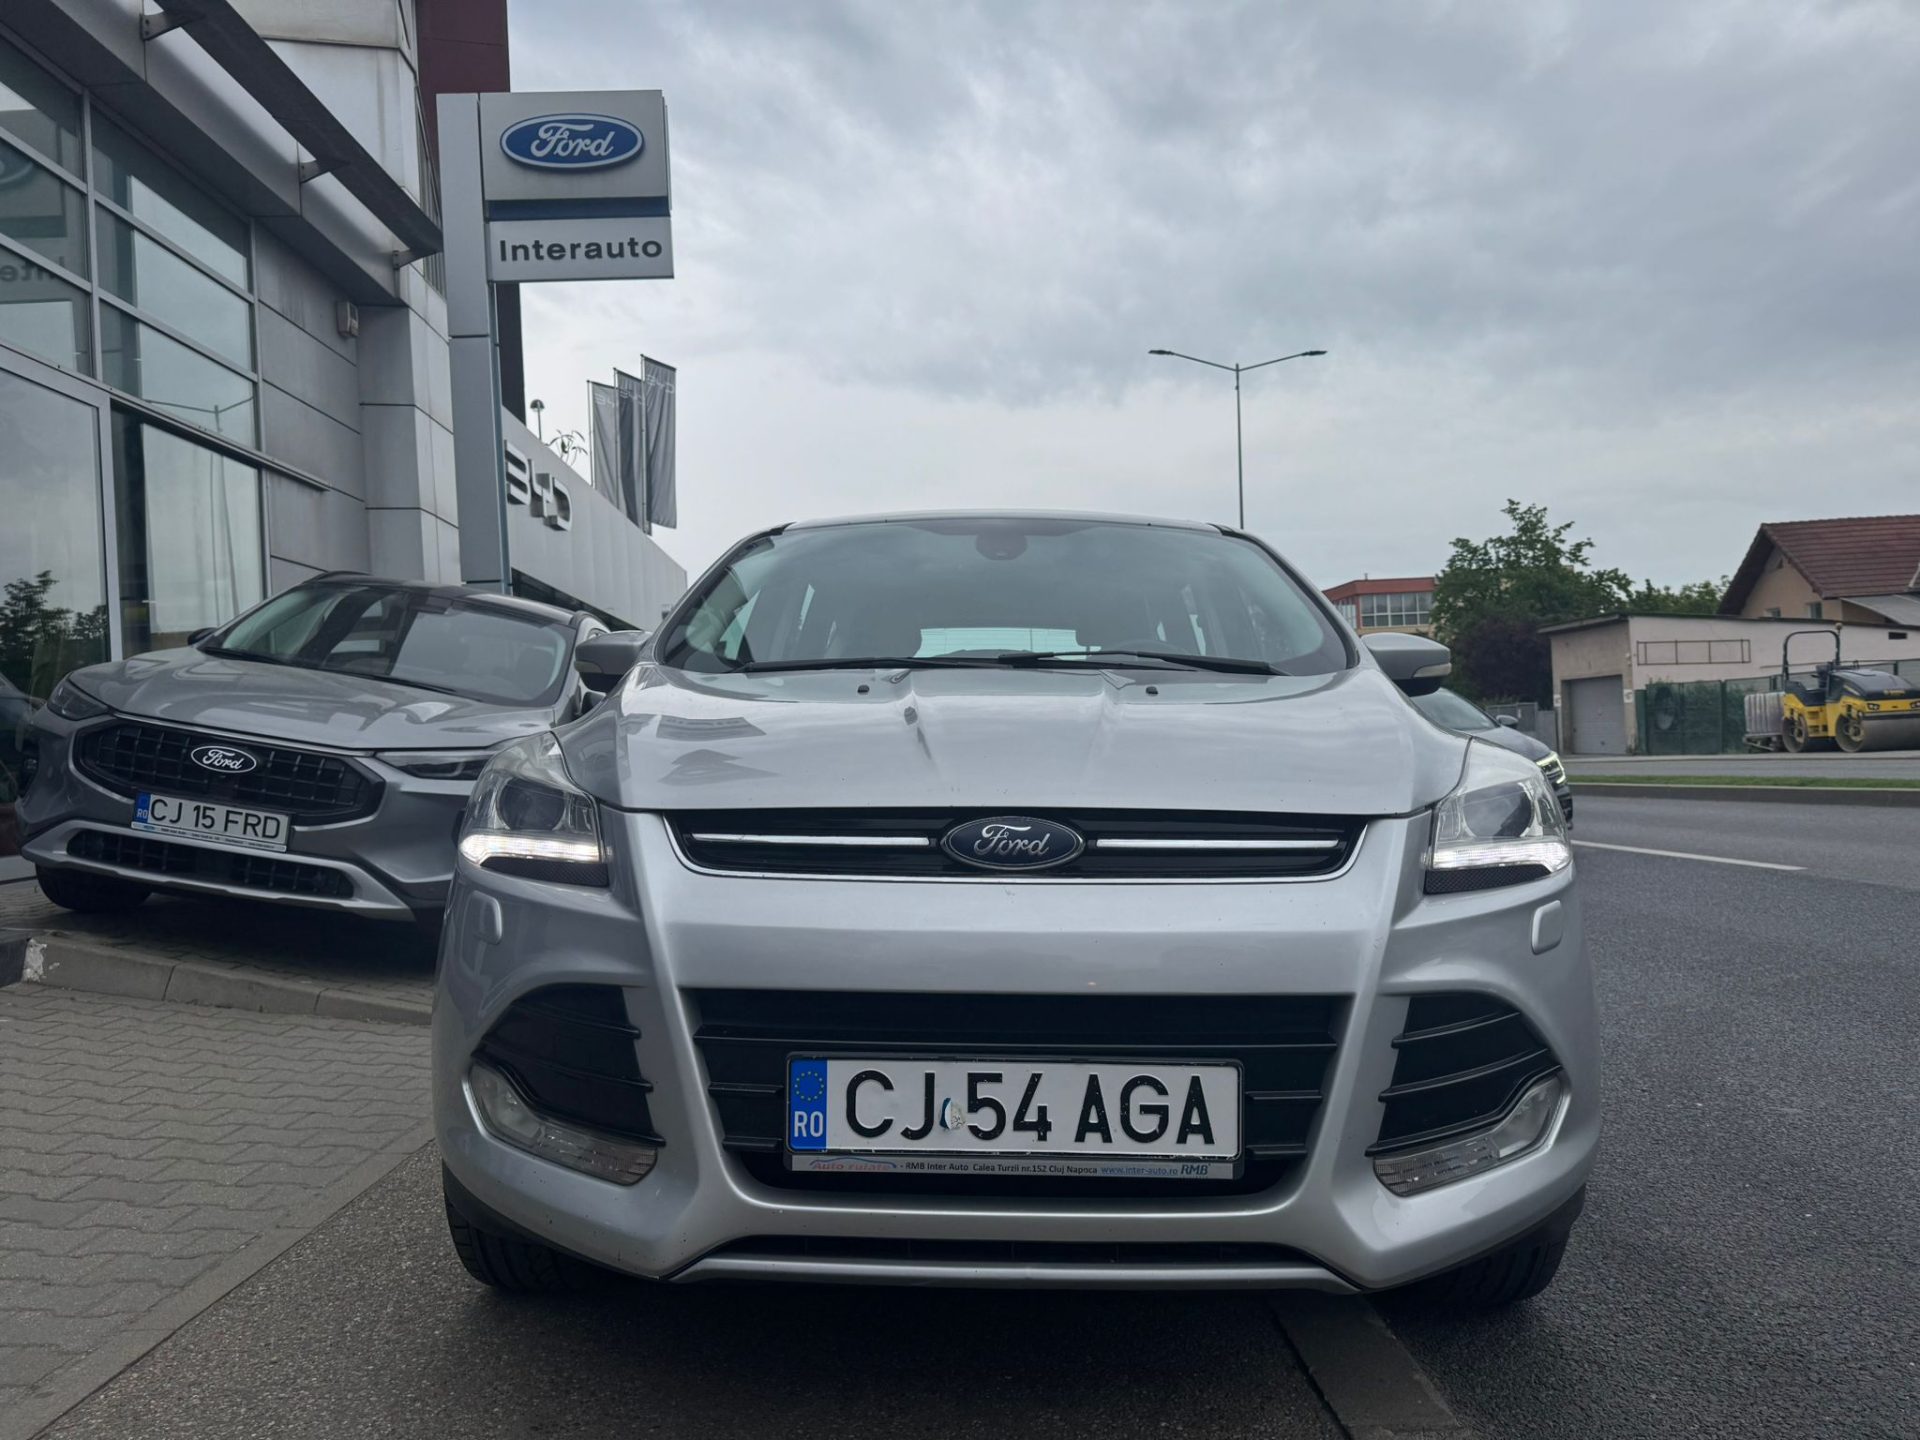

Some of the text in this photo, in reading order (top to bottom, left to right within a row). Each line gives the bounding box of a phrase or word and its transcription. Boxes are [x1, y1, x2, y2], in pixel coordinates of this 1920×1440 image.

[530, 122, 616, 158] Ford
[499, 237, 663, 262] Interauto
[504, 439, 572, 532] BYD
[202, 748, 245, 770] Ford
[150, 799, 281, 839] CJ 15 FRD
[973, 823, 1051, 856] Ford
[846, 1069, 1215, 1145] CJ 54 AGA
[793, 1110, 824, 1138] RO
[905, 1162, 925, 1170] RMB
[927, 1163, 947, 1171] Inter
[949, 1163, 969, 1171] Auto
[973, 1164, 996, 1172] Calea
[1049, 1165, 1065, 1175] Cluj
[1067, 1166, 1098, 1175] Napoca
